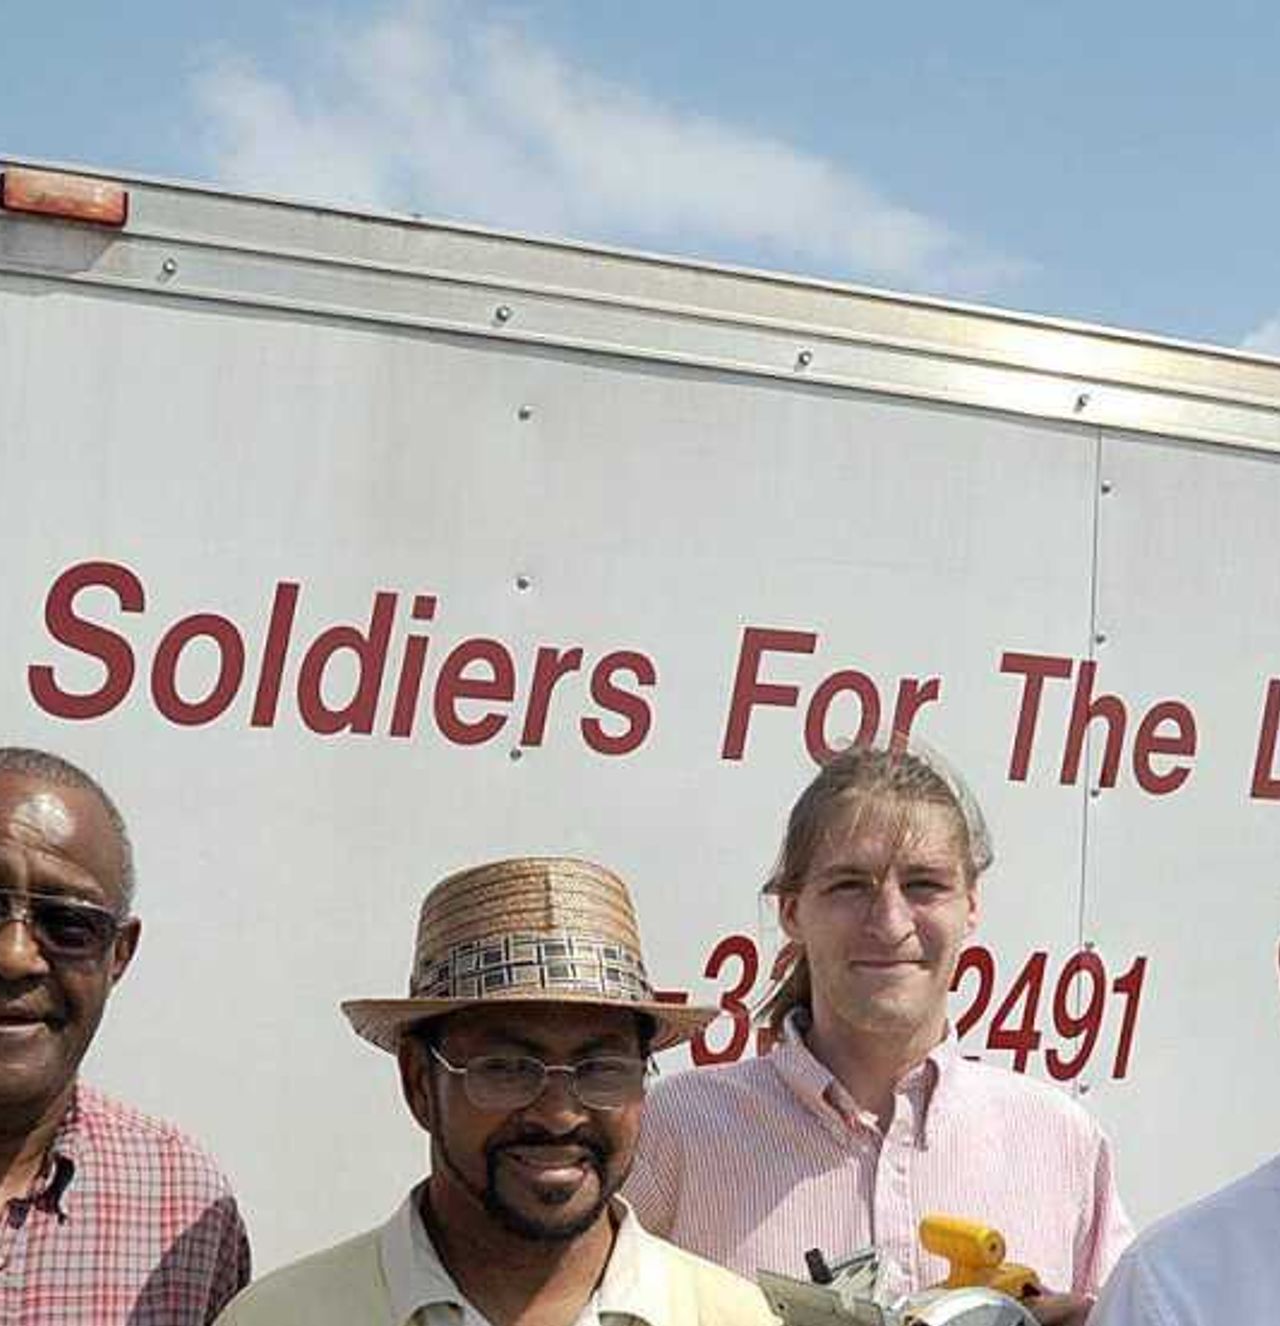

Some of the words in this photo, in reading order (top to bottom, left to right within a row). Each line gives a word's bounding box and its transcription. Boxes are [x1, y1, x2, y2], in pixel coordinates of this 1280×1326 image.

[27, 560, 657, 757] Soldiers
[721, 626, 941, 768] For
[999, 651, 1198, 796] The
